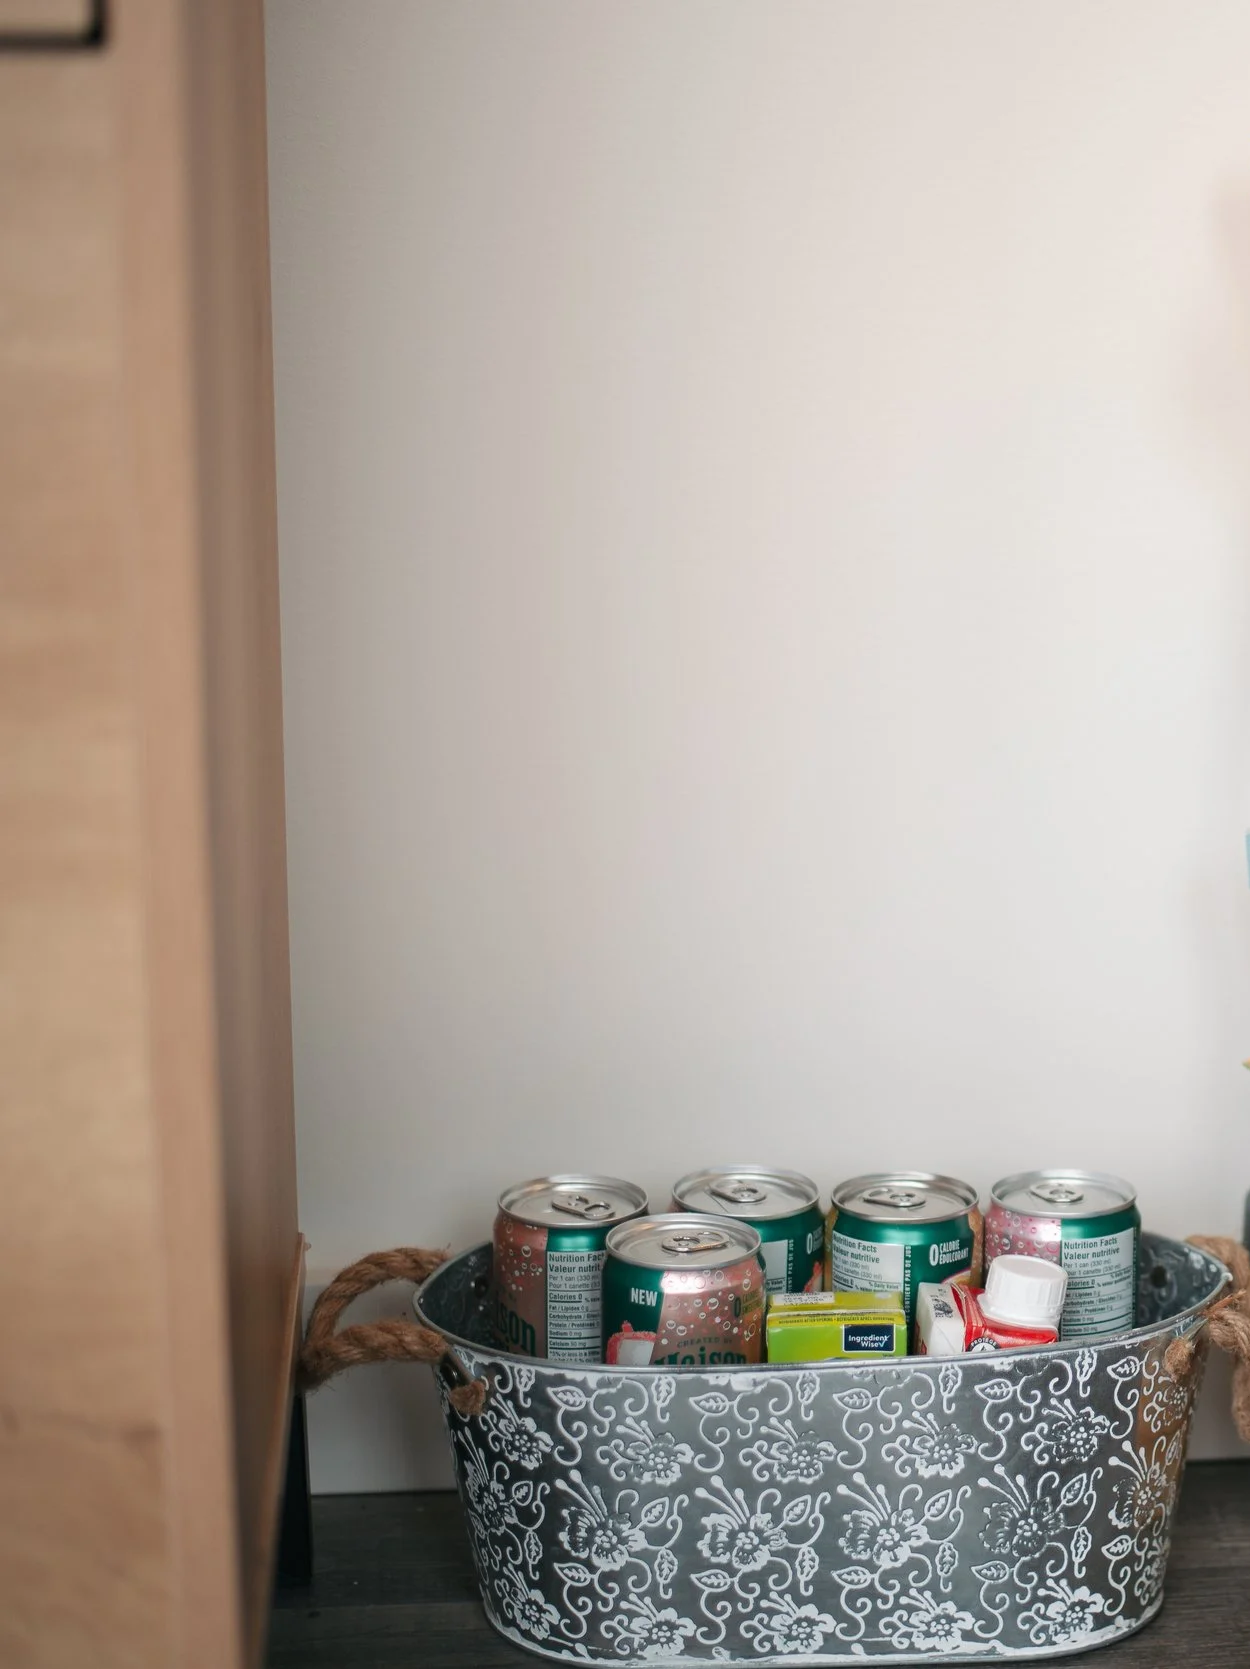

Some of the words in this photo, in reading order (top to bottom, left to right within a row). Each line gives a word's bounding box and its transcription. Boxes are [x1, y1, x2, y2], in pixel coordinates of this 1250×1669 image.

[858, 1242, 877, 1253] Facts
[939, 1239, 960, 1254] CALORIE
[1064, 1241, 1098, 1250] Nutrition
[1100, 1237, 1117, 1246] Facts
[549, 1253, 585, 1262] Nutrition
[587, 1252, 604, 1262] Fact
[851, 1252, 880, 1264] nutritive
[929, 1244, 938, 1267] 0
[1064, 1251, 1090, 1260] Valeur
[1092, 1248, 1120, 1258] nutritive
[549, 1264, 576, 1273] Valeur
[579, 1264, 601, 1273] nutrit
[905, 1261, 911, 1269] DE
[631, 1287, 658, 1307] NEW
[677, 1337, 719, 1348] CREATED
[849, 1334, 888, 1343] Ingredient
